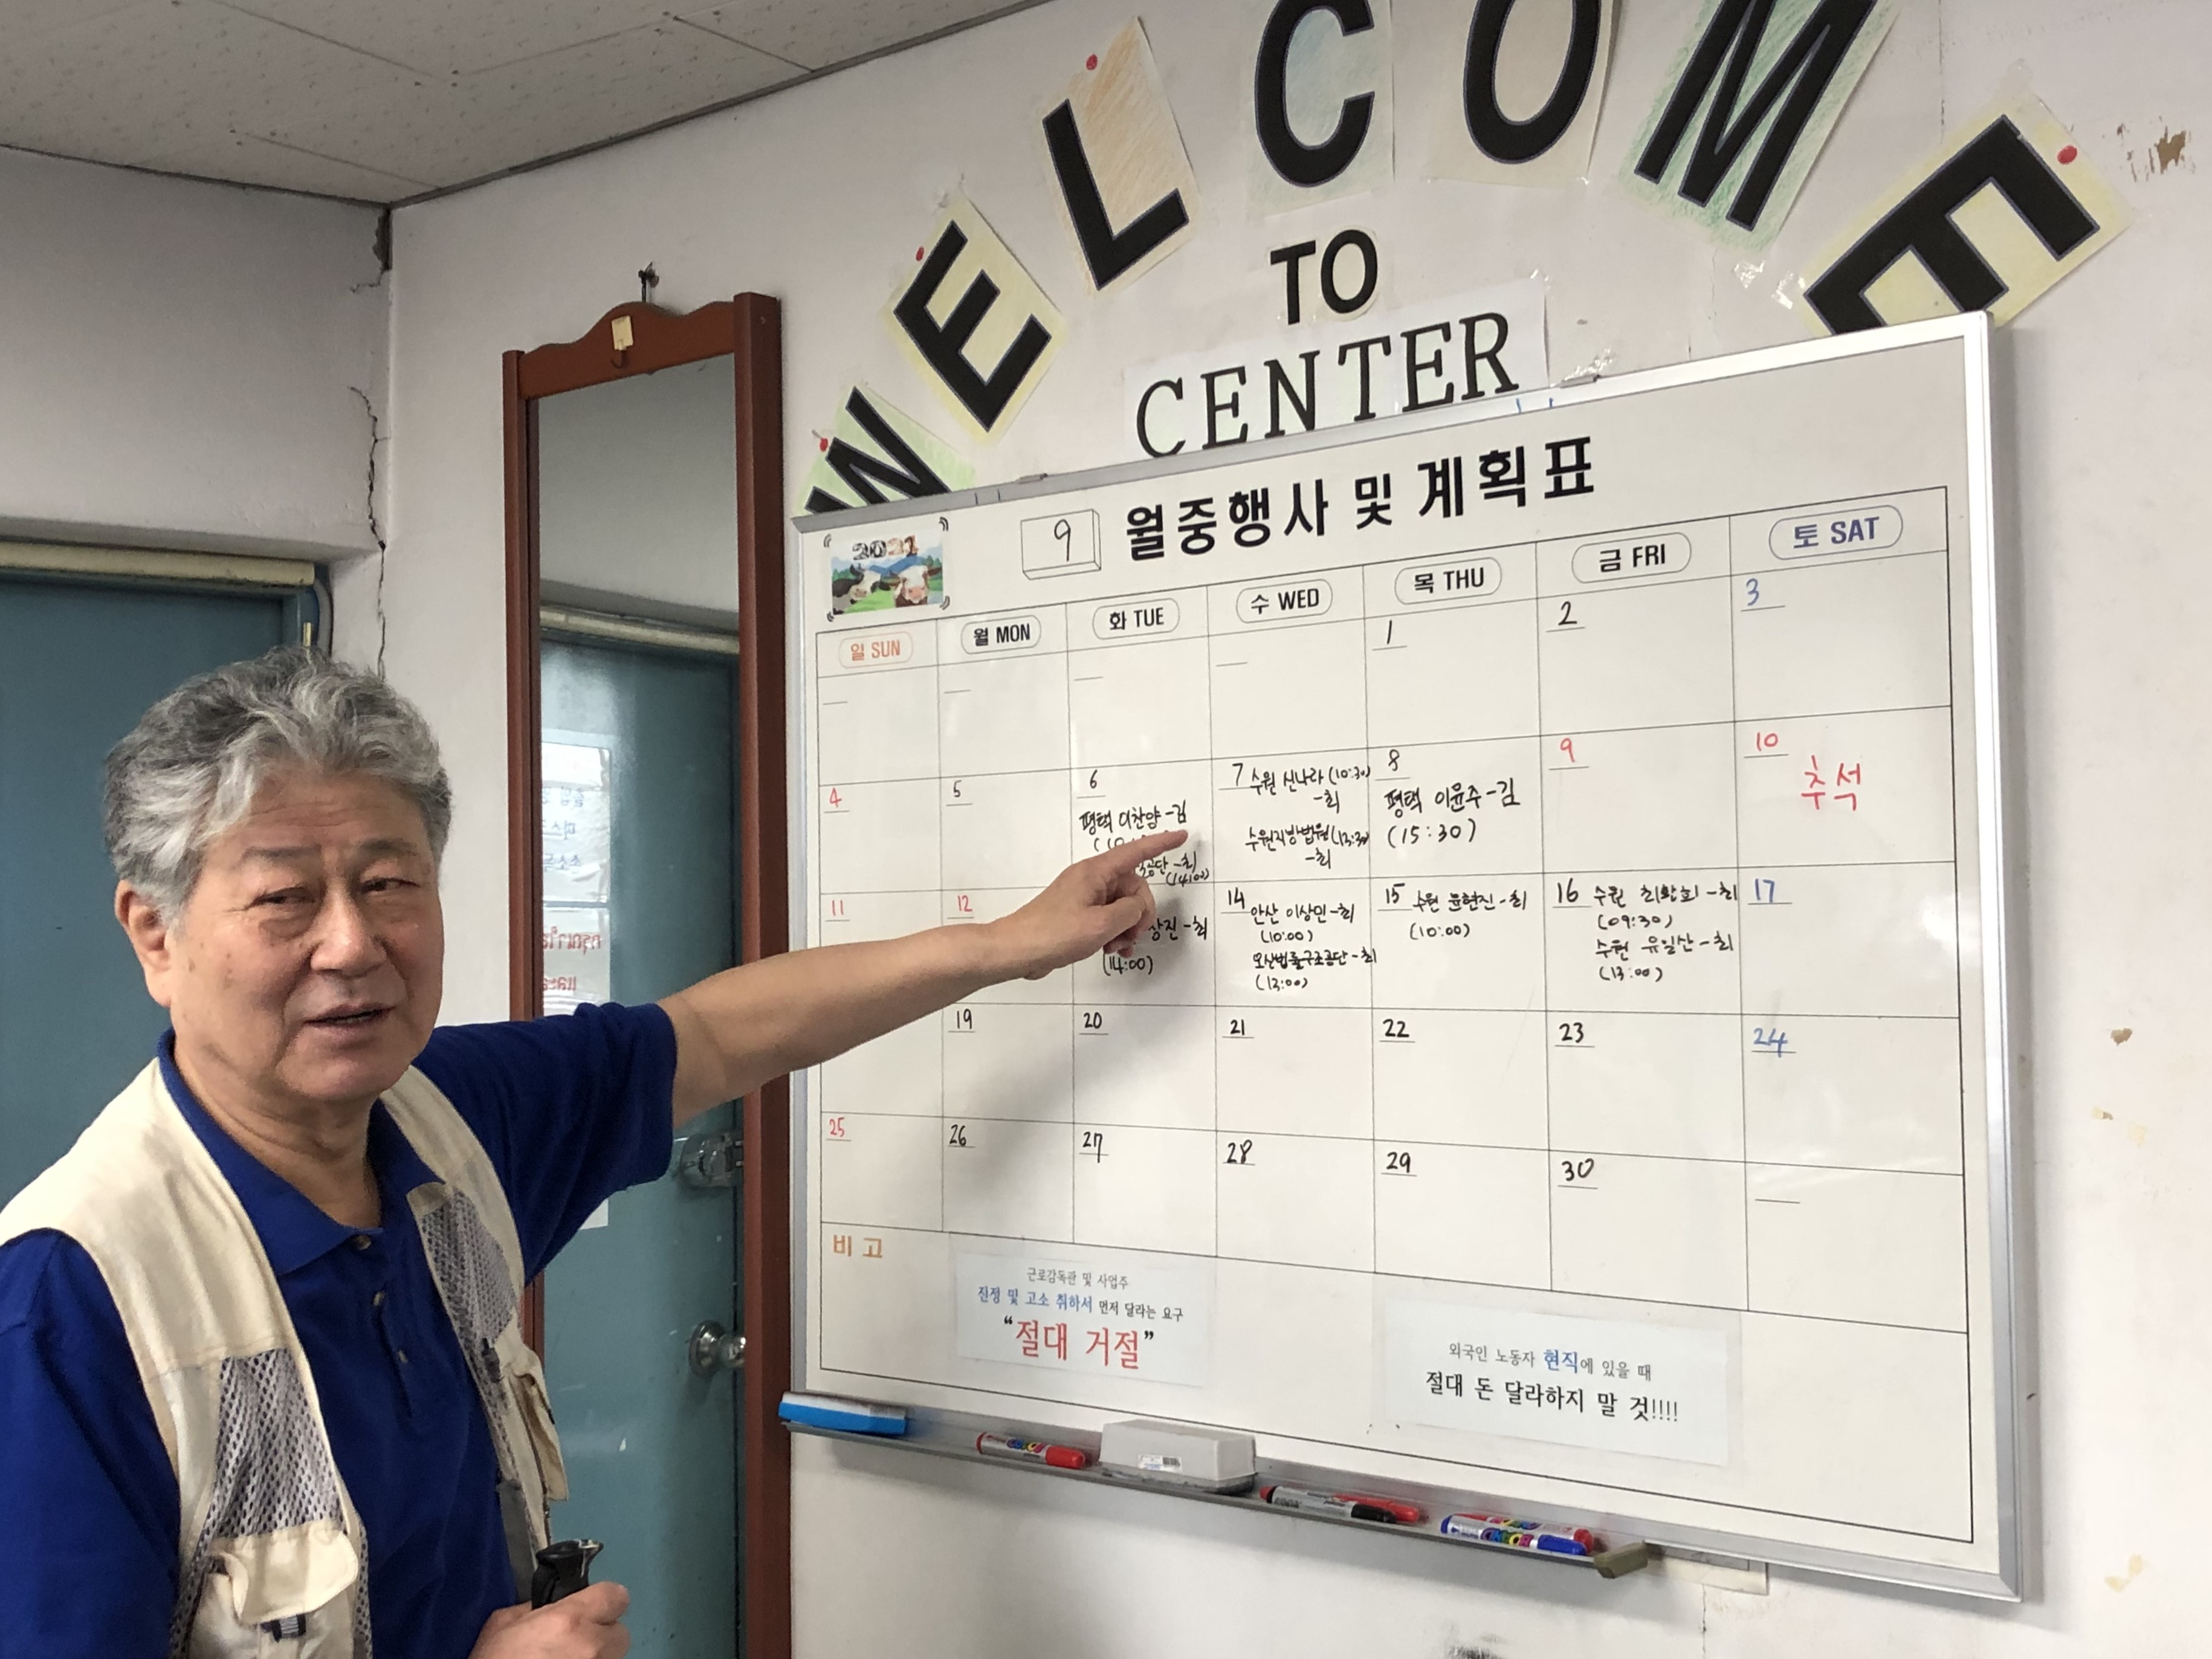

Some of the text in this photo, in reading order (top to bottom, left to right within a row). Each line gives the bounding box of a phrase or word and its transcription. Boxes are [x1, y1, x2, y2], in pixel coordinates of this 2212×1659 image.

[1270, 229, 1377, 325] TO
[1136, 312, 1519, 458] CENTER
[1127, 436, 1594, 561] 월중행사 및 계획표
[1054, 519, 1070, 561] 9
[1794, 517, 1880, 548] 토 SAT
[852, 535, 919, 560] 2021
[1600, 544, 1666, 572] 금 FRI
[1414, 568, 1484, 594] 목 THU
[1745, 578, 1759, 606] 3
[1251, 590, 1319, 613] 수 WED
[1557, 601, 1577, 626] 2
[1109, 607, 1164, 630] 화 TUE
[973, 624, 1030, 646] 월 MON
[1386, 620, 1393, 645] 1
[850, 640, 901, 661] 일 SUN
[1560, 738, 1575, 762] 9
[1756, 732, 1779, 751] 10
[1388, 749, 1400, 771] 8
[953, 780, 962, 797] 5
[1090, 769, 1098, 789] 6
[1232, 763, 1243, 786] 7
[1250, 768, 1276, 795] 수원
[1801, 755, 1861, 810] 추석
[829, 787, 842, 807] 4
[1228, 887, 1245, 909] 14
[1386, 883, 1405, 904] 15
[1412, 890, 1440, 913] 수원
[1557, 878, 1579, 903] 16
[1594, 885, 1626, 908] 수원
[1755, 878, 1774, 903] 17
[832, 900, 844, 916] 11
[957, 895, 972, 912] 12
[1251, 902, 1279, 925] 안산
[1596, 939, 1629, 961] 수원
[957, 1009, 972, 1029] 19
[1083, 1012, 1102, 1029] 20
[1231, 1019, 1244, 1035] 21
[1383, 1018, 1409, 1037] 22
[1559, 1022, 1584, 1043] 23
[1753, 1027, 1788, 1057] 24
[829, 1117, 845, 1137] 25
[949, 1125, 966, 1146] 26
[1083, 1131, 1102, 1163] 27
[1226, 1139, 1253, 1165] 28
[1386, 1152, 1411, 1172] 29
[1562, 1158, 1594, 1182] 30
[1027, 1267, 1128, 1290] 근로감독관 및 사업주
[978, 1286, 1183, 1323] 진정 및 고소 취하서 먼저 달라는 요구
[1449, 1342, 1487, 1363] 외국인
[1495, 1348, 1536, 1368] 노동자
[1602, 1360, 1629, 1380] 있을
[1638, 1363, 1651, 1382] 때
[1426, 1370, 1463, 1397] 절대
[1474, 1377, 1494, 1402] 돈
[1505, 1380, 1584, 1412] 달라하지
[1597, 1391, 1617, 1417] 말
